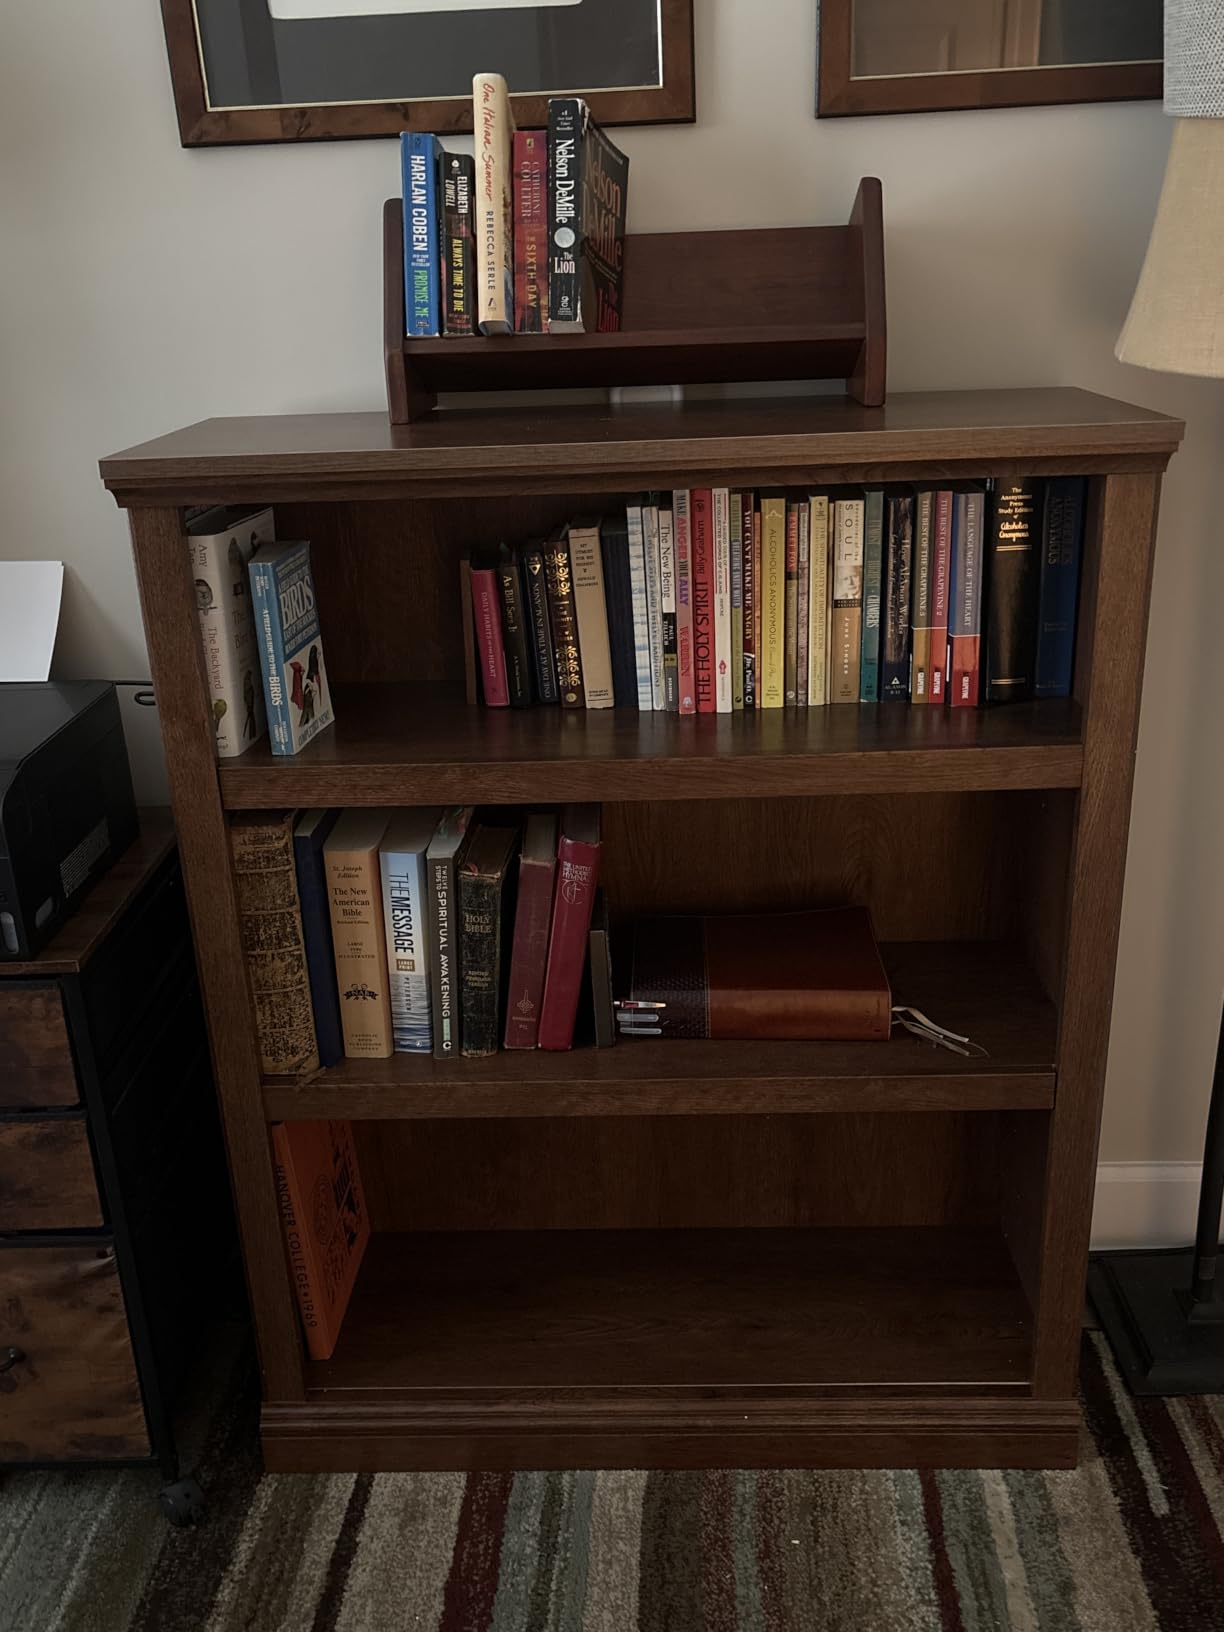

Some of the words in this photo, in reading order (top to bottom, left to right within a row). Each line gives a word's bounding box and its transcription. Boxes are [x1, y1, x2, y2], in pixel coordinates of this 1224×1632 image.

[483, 83, 495, 104] One
[482, 107, 497, 148] Italian
[554, 138, 574, 178] Nelson
[410, 155, 428, 204] HARLAN
[482, 151, 497, 200] Summer
[445, 180, 456, 207] LOWELL
[456, 176, 468, 213] ELIZABETH
[521, 161, 532, 218] COULTER
[532, 162, 541, 216] CATHERINE
[554, 180, 576, 224] DeMille
[412, 208, 429, 251] COBEN
[486, 211, 496, 256] REBECCA
[452, 239, 463, 267] ALWAYS
[526, 244, 537, 279] SIXTH
[564, 252, 574, 260] The
[452, 269, 464, 288] TIME
[488, 261, 496, 290] SERLE
[554, 258, 576, 274] Lion
[414, 270, 428, 303] PROMISE
[453, 290, 464, 298] TO
[528, 284, 538, 308] DAY
[415, 307, 428, 317] ME
[453, 299, 464, 312] DIE
[676, 495, 687, 516] MAKE
[922, 500, 930, 516] THE
[940, 499, 948, 515] THE
[967, 504, 976, 521] THE
[660, 526, 670, 544] The
[678, 516, 688, 559] ANGER
[695, 520, 704, 556] Graham
[788, 516, 796, 548] EMMET
[844, 504, 854, 560] SOUL
[922, 517, 930, 536] BEST
[1048, 496, 1062, 565] ANONYMOUS
[1062, 496, 1076, 565] ALCOHOLICS
[744, 532, 752, 560] CAN'T
[900, 540, 910, 561] How
[922, 537, 930, 548] OF
[939, 536, 946, 547] OF
[966, 522, 975, 565] LANGUAGE
[198, 544, 208, 568] Amy
[661, 548, 672, 568] New
[696, 556, 707, 574] Billy
[768, 529, 777, 586] ALCOHOLICS
[788, 551, 796, 568] FOX
[922, 550, 930, 564] THE
[938, 550, 946, 564] THE
[503, 576, 512, 587] As
[678, 560, 688, 578] YOUR
[744, 562, 752, 590] MAKE
[966, 566, 973, 577] OF
[660, 570, 673, 598] Being
[680, 578, 689, 606] ALLY
[819, 588, 824, 598] OF
[920, 565, 929, 610] GRAPEVINE
[937, 564, 946, 610] GRAPEVINE
[964, 582, 972, 598] THE
[280, 575, 314, 629] BIRDS
[505, 590, 514, 604] Bill
[695, 580, 709, 628] SPIRIT
[745, 592, 752, 607] ME
[537, 618, 544, 627] IN
[769, 588, 778, 645] ANONYMOUS
[866, 594, 880, 628] CHAMBERS
[898, 604, 909, 634] Works
[964, 599, 972, 626] HEART
[208, 627, 218, 645] The
[538, 628, 546, 647] TIME
[542, 656, 548, 666] AT
[680, 625, 690, 677] WARREN
[697, 631, 710, 676] HOLY
[210, 648, 224, 690] Backyard
[268, 676, 284, 706] BIRDS
[698, 679, 711, 704] THE
[916, 672, 926, 694] GRAPEVINE
[934, 672, 942, 694] GRAPEVINE
[961, 676, 970, 700] GRAPEVINE
[343, 866, 362, 874] Joseph
[332, 898, 370, 906] American
[334, 888, 348, 896] The
[350, 888, 367, 896] New
[342, 908, 362, 916] Bible
[438, 891, 448, 950] SPIRITUAL
[465, 914, 491, 924] HOLY
[464, 924, 492, 932] BIBLE
[404, 976, 412, 1011] PETERSON
[440, 954, 451, 1018] AWAKENING
[274, 1165, 296, 1226] HANOVER
[288, 1232, 310, 1288] COLLEGE
[303, 1299, 318, 1328] 1969
